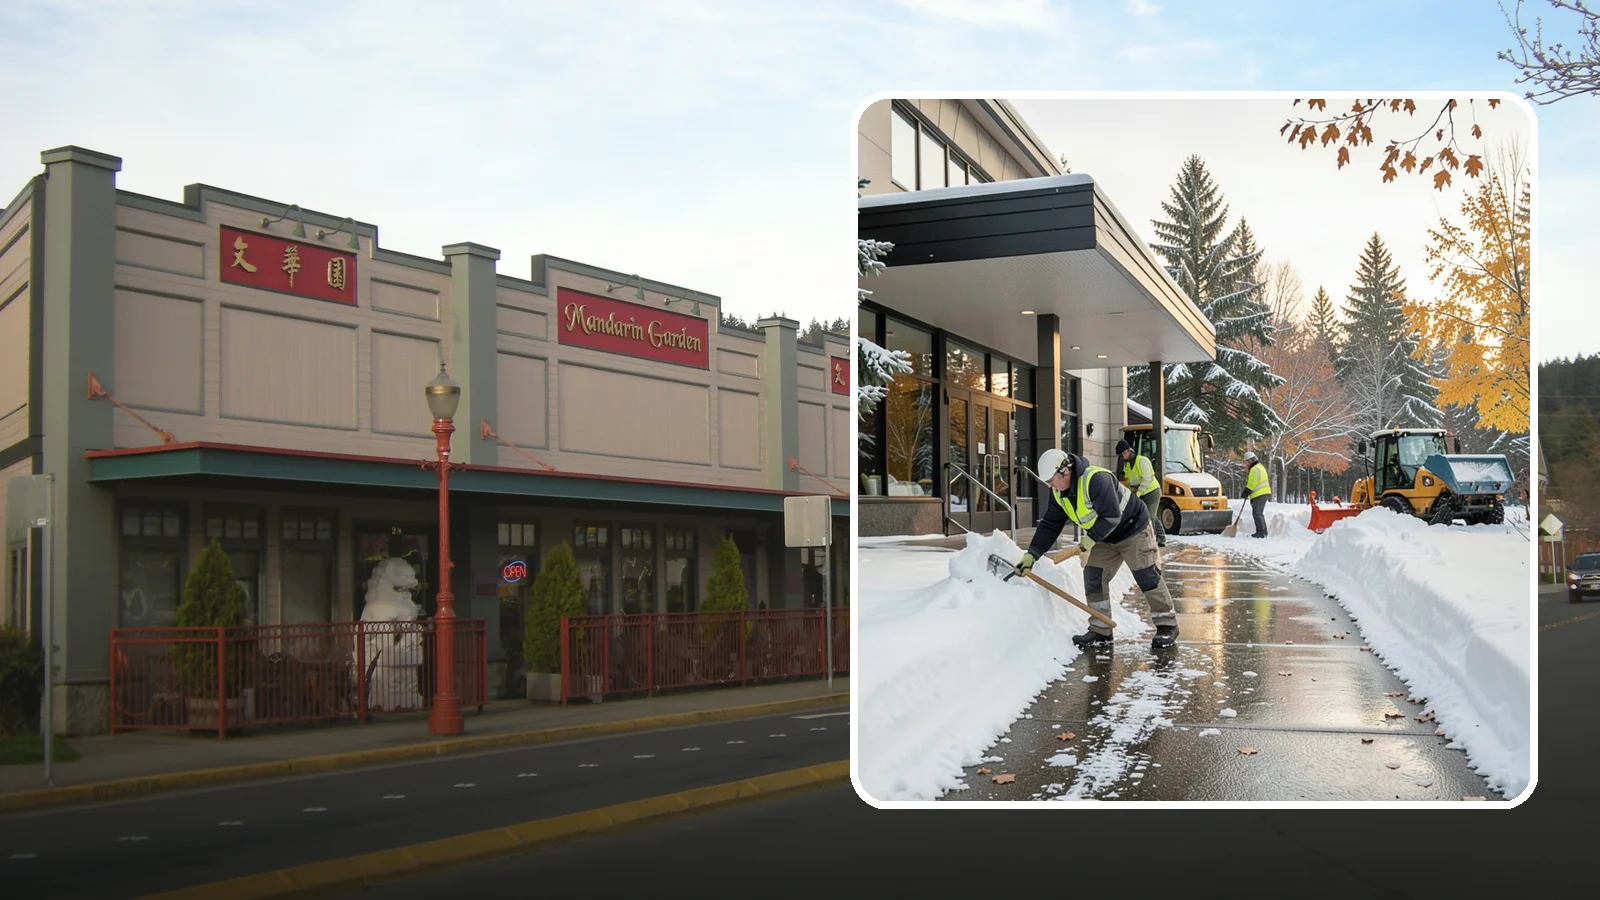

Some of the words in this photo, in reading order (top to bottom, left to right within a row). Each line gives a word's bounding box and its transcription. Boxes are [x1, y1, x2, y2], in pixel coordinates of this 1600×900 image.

[231, 235, 346, 292] 文華園
[564, 301, 644, 342] Mandarin
[647, 319, 702, 353] Garden
[503, 565, 527, 578] OPEN
